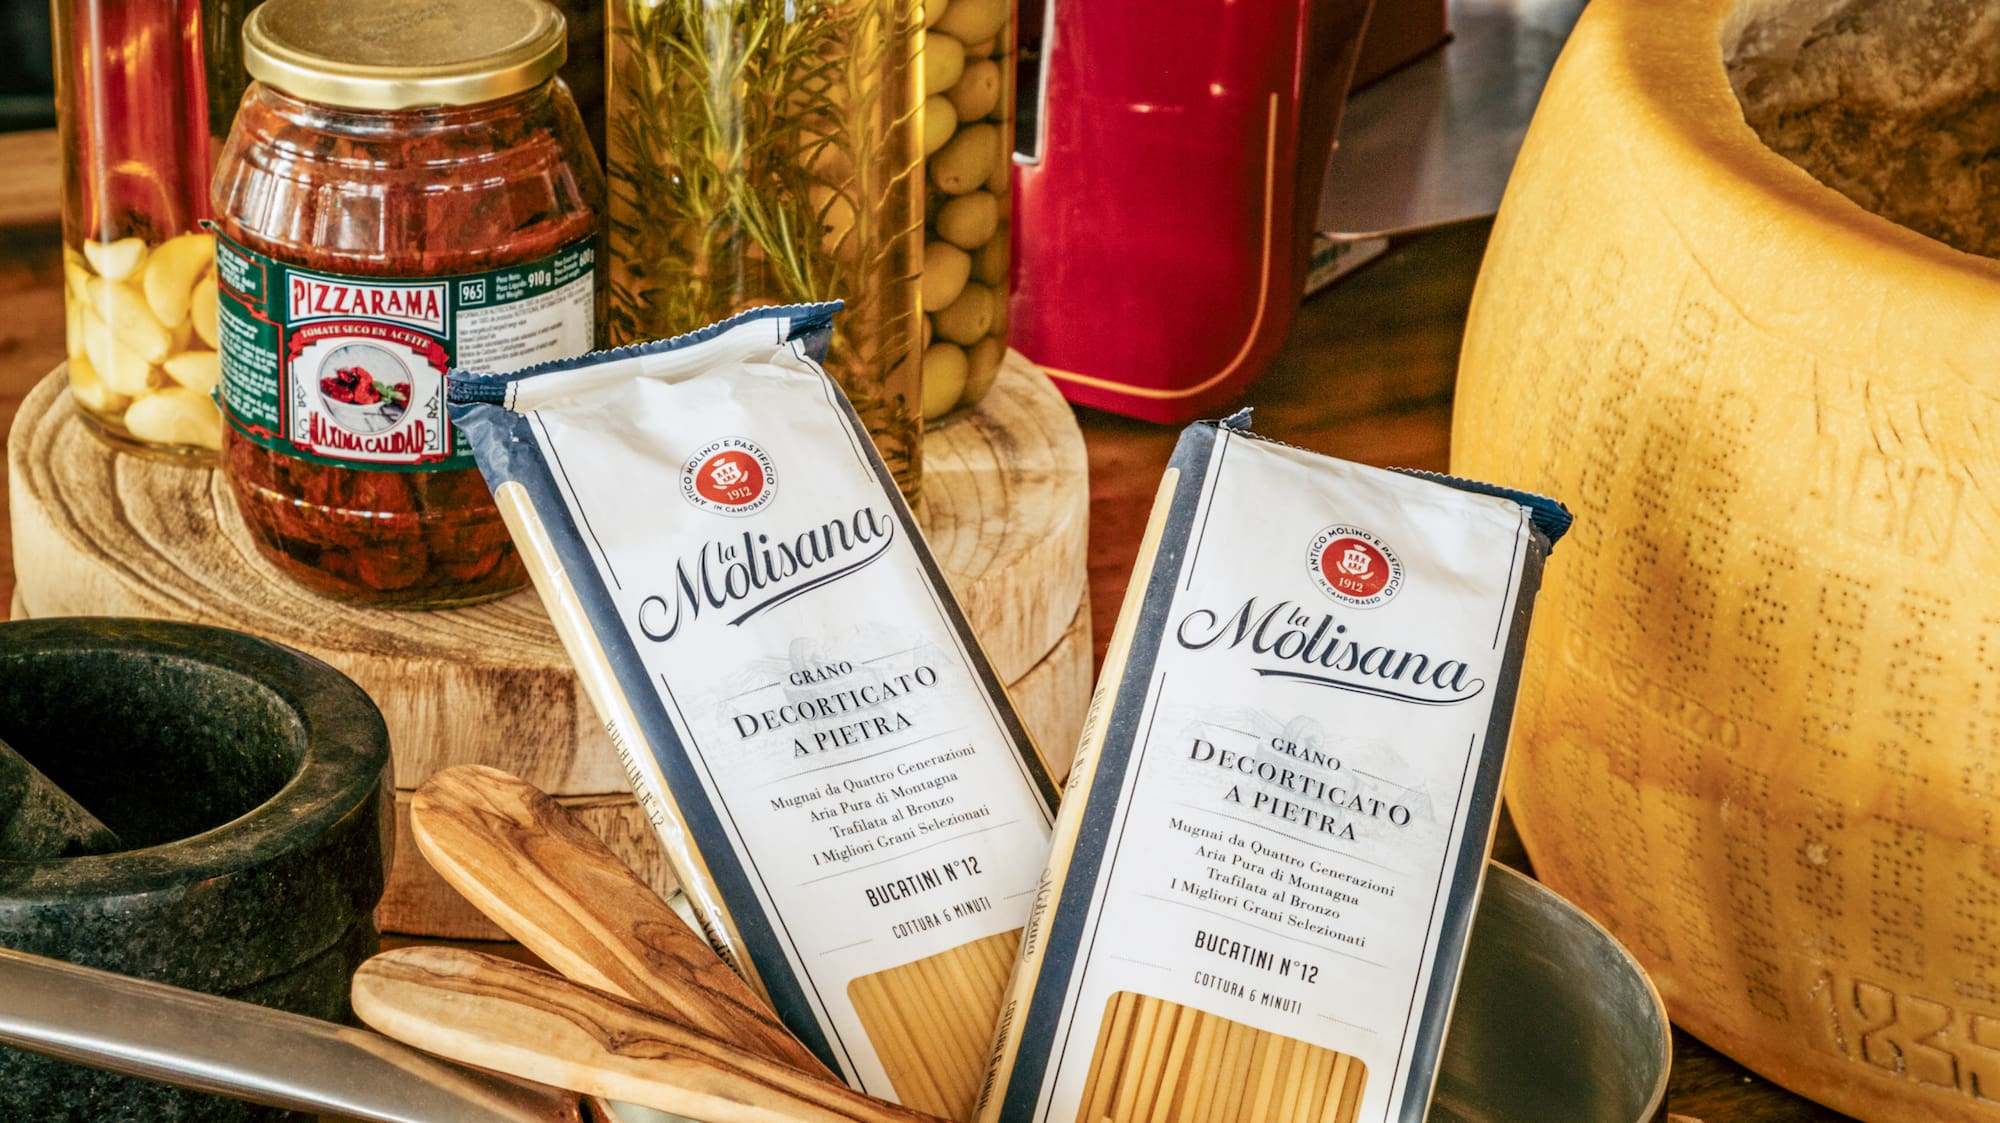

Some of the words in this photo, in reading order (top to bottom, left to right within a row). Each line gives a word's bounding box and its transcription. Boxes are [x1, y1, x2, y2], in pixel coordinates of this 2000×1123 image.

[293, 278, 440, 321] PIZZARAMA
[462, 284, 482, 300] 965
[496, 284, 508, 292] Peso
[302, 324, 341, 338] TOMATE
[342, 325, 370, 335] SECO
[372, 327, 386, 336] EN
[390, 331, 430, 349] ACEITE
[364, 420, 425, 454] CALIDAD
[686, 443, 720, 475] MOLINO
[734, 440, 774, 485] PASTIFICIO
[684, 476, 707, 506] ANTICO
[726, 486, 752, 501] 1912
[638, 506, 894, 642] Molisana
[717, 541, 736, 564] la
[1310, 536, 1327, 572] ANTICO
[1328, 528, 1372, 540] MOLINO
[1382, 547, 1401, 596] PASTIFICIO
[1338, 577, 1363, 592] 1912
[1287, 606, 1312, 627] la
[1176, 596, 1485, 706] Molisana
[790, 661, 853, 686] GRANO
[732, 666, 937, 740] DECORTICATO
[794, 738, 809, 758] A
[813, 711, 913, 750] PIETRA
[1271, 737, 1341, 771] GRANO
[770, 788, 821, 811] Mugnai
[825, 783, 841, 797] da
[843, 770, 895, 794] Quattro
[896, 744, 976, 777] Generazioni
[810, 807, 837, 822] Aria
[840, 800, 872, 815] Pura
[875, 793, 888, 804] di
[891, 773, 959, 801] Montagna
[1188, 738, 1411, 826] DECORTICATO
[813, 854, 820, 866] I
[822, 841, 874, 864] Migliori
[877, 828, 916, 847] Grani
[919, 804, 991, 835] Selezionati
[830, 817, 888, 839] Trafilata
[892, 809, 904, 823] al
[906, 795, 955, 817] Bronzo
[1225, 785, 1241, 803] A
[1253, 791, 1356, 841] PIETRA
[1169, 817, 1223, 841] Mugnai
[1228, 834, 1245, 849] da
[1251, 840, 1305, 869] Quattro
[1310, 860, 1396, 897] Generazioni
[1195, 845, 1226, 863] Aria
[1232, 854, 1265, 875] Pura
[1270, 868, 1283, 881] di
[1288, 873, 1359, 906] Montagna
[865, 868, 942, 908] BUCATINI
[1207, 866, 1267, 897] Trafilata
[1272, 889, 1286, 901] al
[1290, 895, 1340, 920] Bronzo
[892, 912, 941, 939] COTTURA
[943, 909, 951, 922] 6
[953, 896, 992, 918] MINUTI
[1171, 878, 1177, 889] I
[1181, 880, 1239, 907] Migliori
[1243, 899, 1283, 923] Grani
[1287, 914, 1366, 948] Selezionati
[1194, 930, 1274, 971] BUCATINI
[1194, 971, 1244, 998] COTTURA
[1250, 989, 1257, 1002] 6
[1260, 992, 1302, 1015] MINUTI
